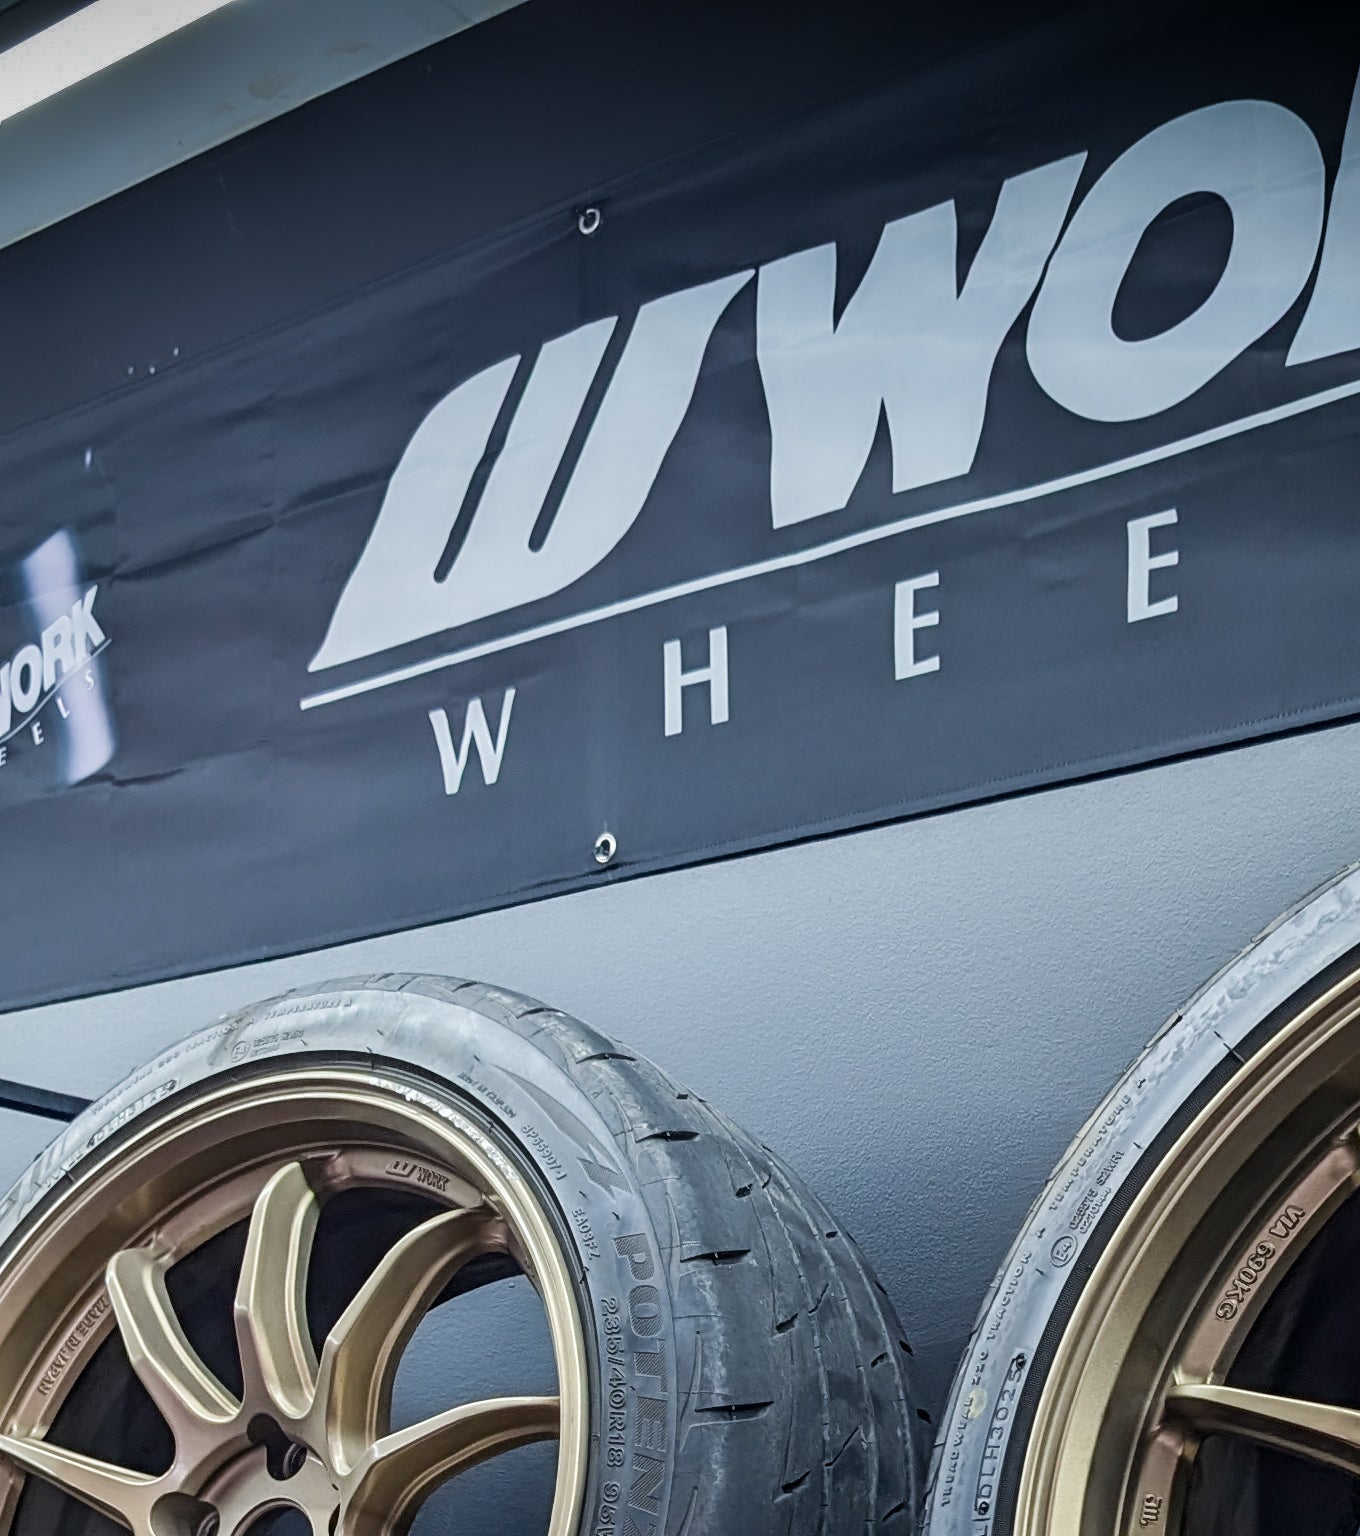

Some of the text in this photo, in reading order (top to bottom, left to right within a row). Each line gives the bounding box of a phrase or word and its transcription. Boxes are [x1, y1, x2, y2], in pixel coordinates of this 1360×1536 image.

[416, 1165, 451, 1193] WORK
[1216, 1205, 1306, 1322] VIA 690KG
[39, 1351, 71, 1396] JAPAN
[599, 1296, 627, 1468] 235/40R18
